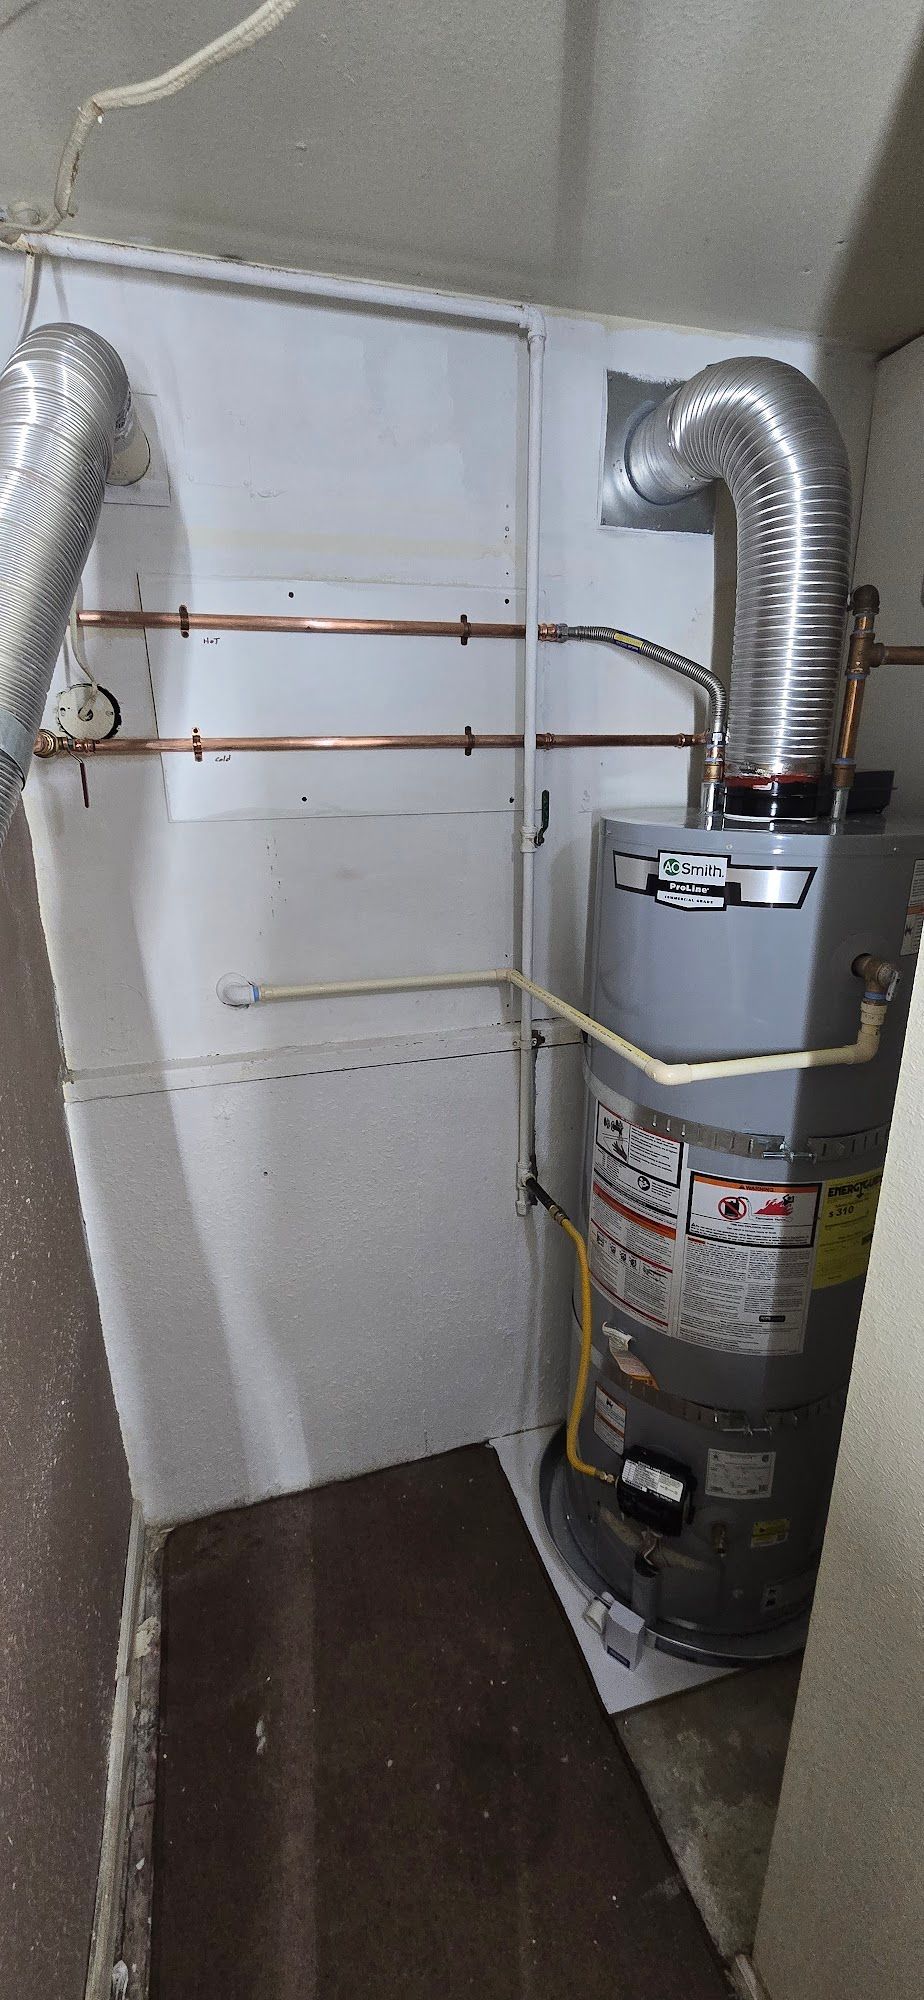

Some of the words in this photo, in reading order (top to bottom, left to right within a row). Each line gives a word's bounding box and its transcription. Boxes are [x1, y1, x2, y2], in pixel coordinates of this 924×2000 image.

[669, 882, 710, 894] ProLine
[745, 1185, 775, 1193] WARNING
[835, 1205, 855, 1217] 310
